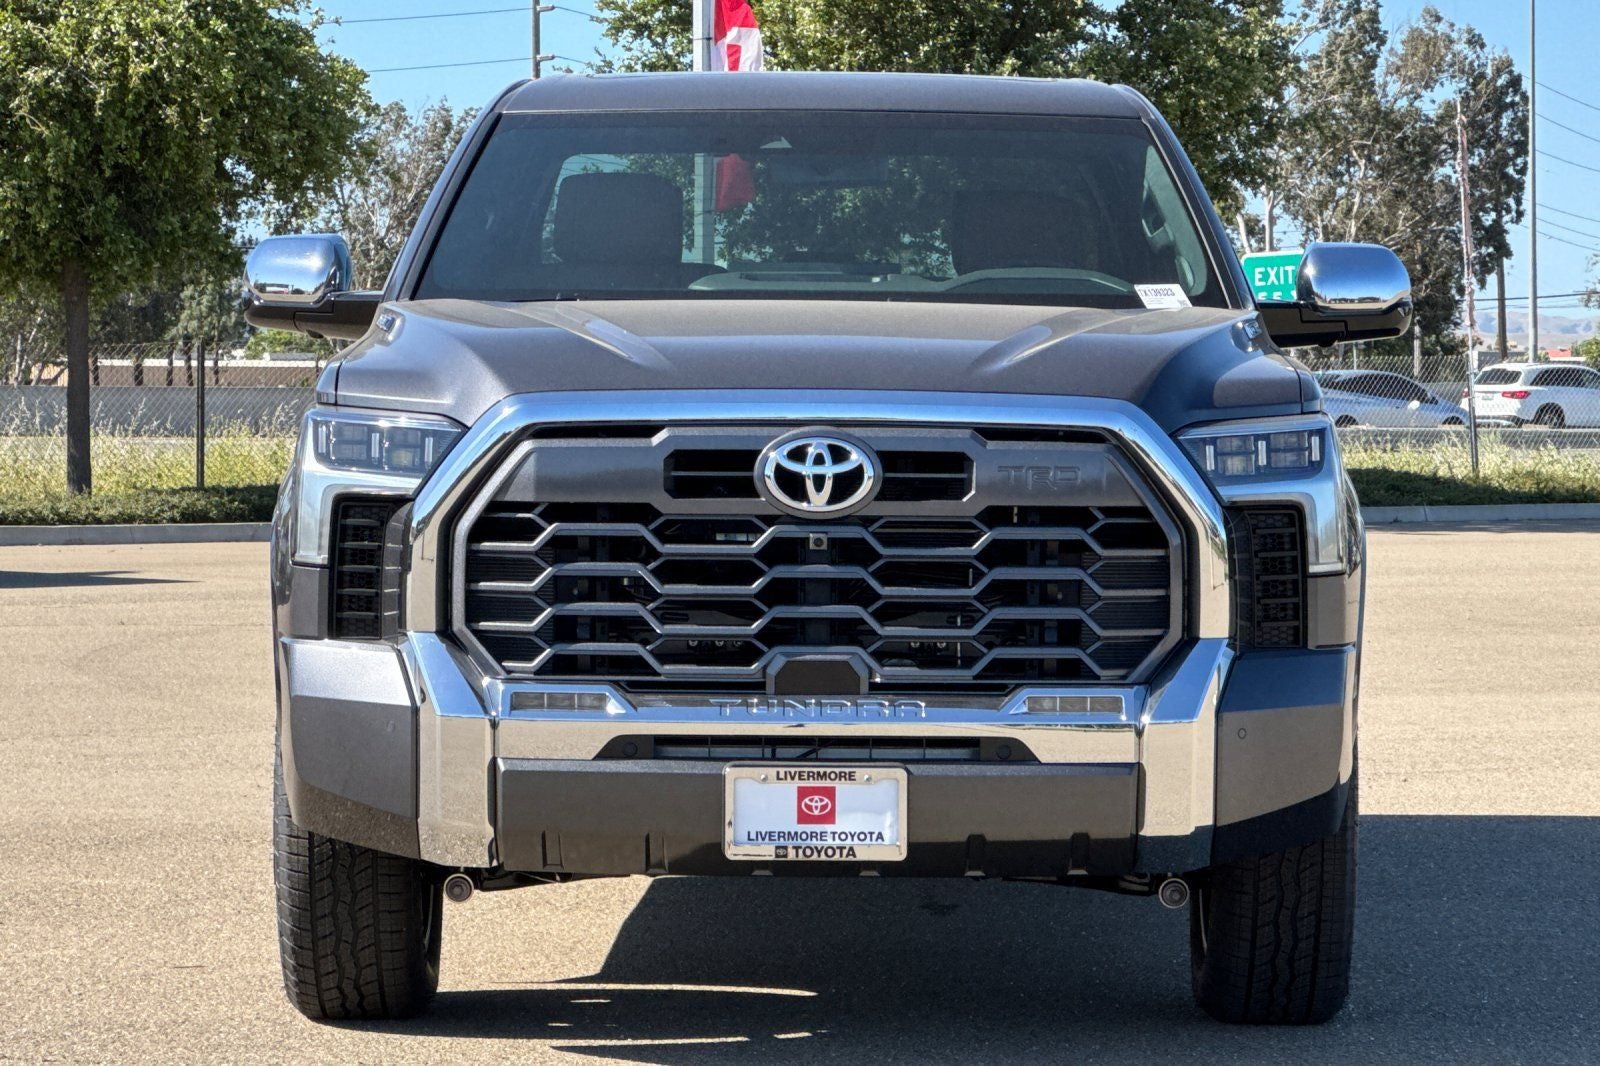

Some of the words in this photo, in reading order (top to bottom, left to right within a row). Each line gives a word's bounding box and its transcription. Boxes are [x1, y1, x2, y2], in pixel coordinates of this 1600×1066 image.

[1254, 265, 1296, 287] EXIT
[997, 465, 1081, 490] TRD
[708, 698, 926, 718] TUNDRA
[775, 770, 857, 782] LIVERMORE
[747, 830, 828, 842] LIVERMORE
[831, 830, 885, 842] TOYOTA
[792, 845, 857, 859] TOYOTA
